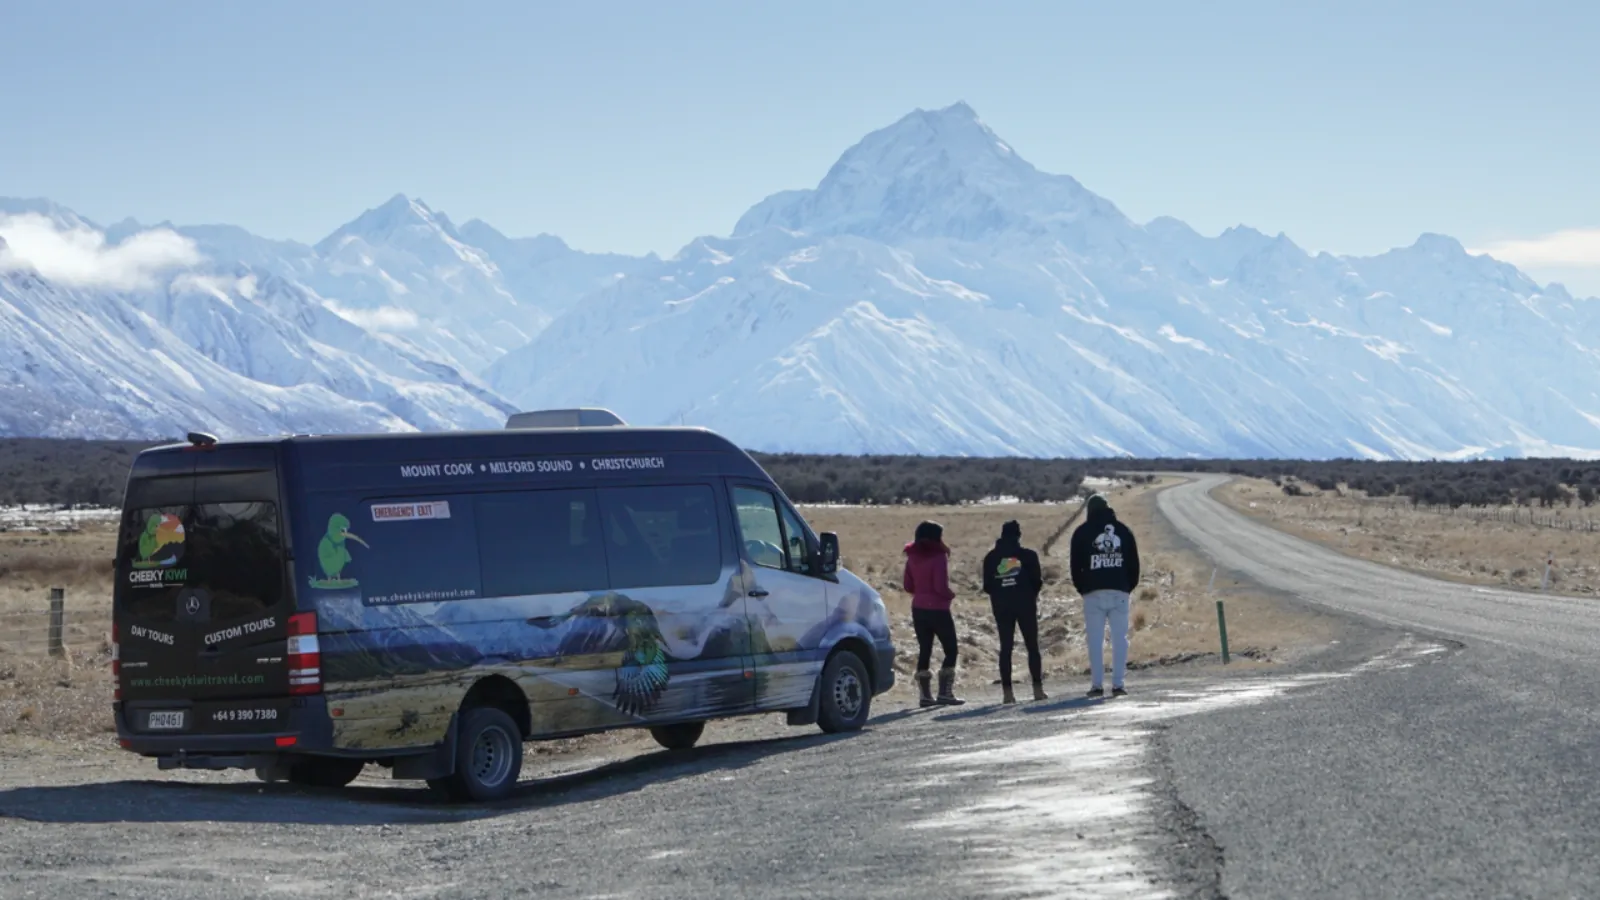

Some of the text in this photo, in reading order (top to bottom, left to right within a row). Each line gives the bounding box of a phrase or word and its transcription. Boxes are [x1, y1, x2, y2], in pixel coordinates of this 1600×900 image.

[400, 462, 474, 478] MOUNT COOK
[489, 459, 573, 475] MILFORD SOUND
[591, 456, 665, 471] CHRISTCHURCH
[374, 504, 433, 518] EMERGENCY EXIT
[129, 568, 188, 583] CHEEKY KIWI
[131, 625, 175, 645] DAY TOURS
[204, 616, 276, 645] CUSTOM TOURS
[130, 673, 265, 687] www.cheekykiwitravel.com
[212, 709, 277, 721] +64 9 390 7380
